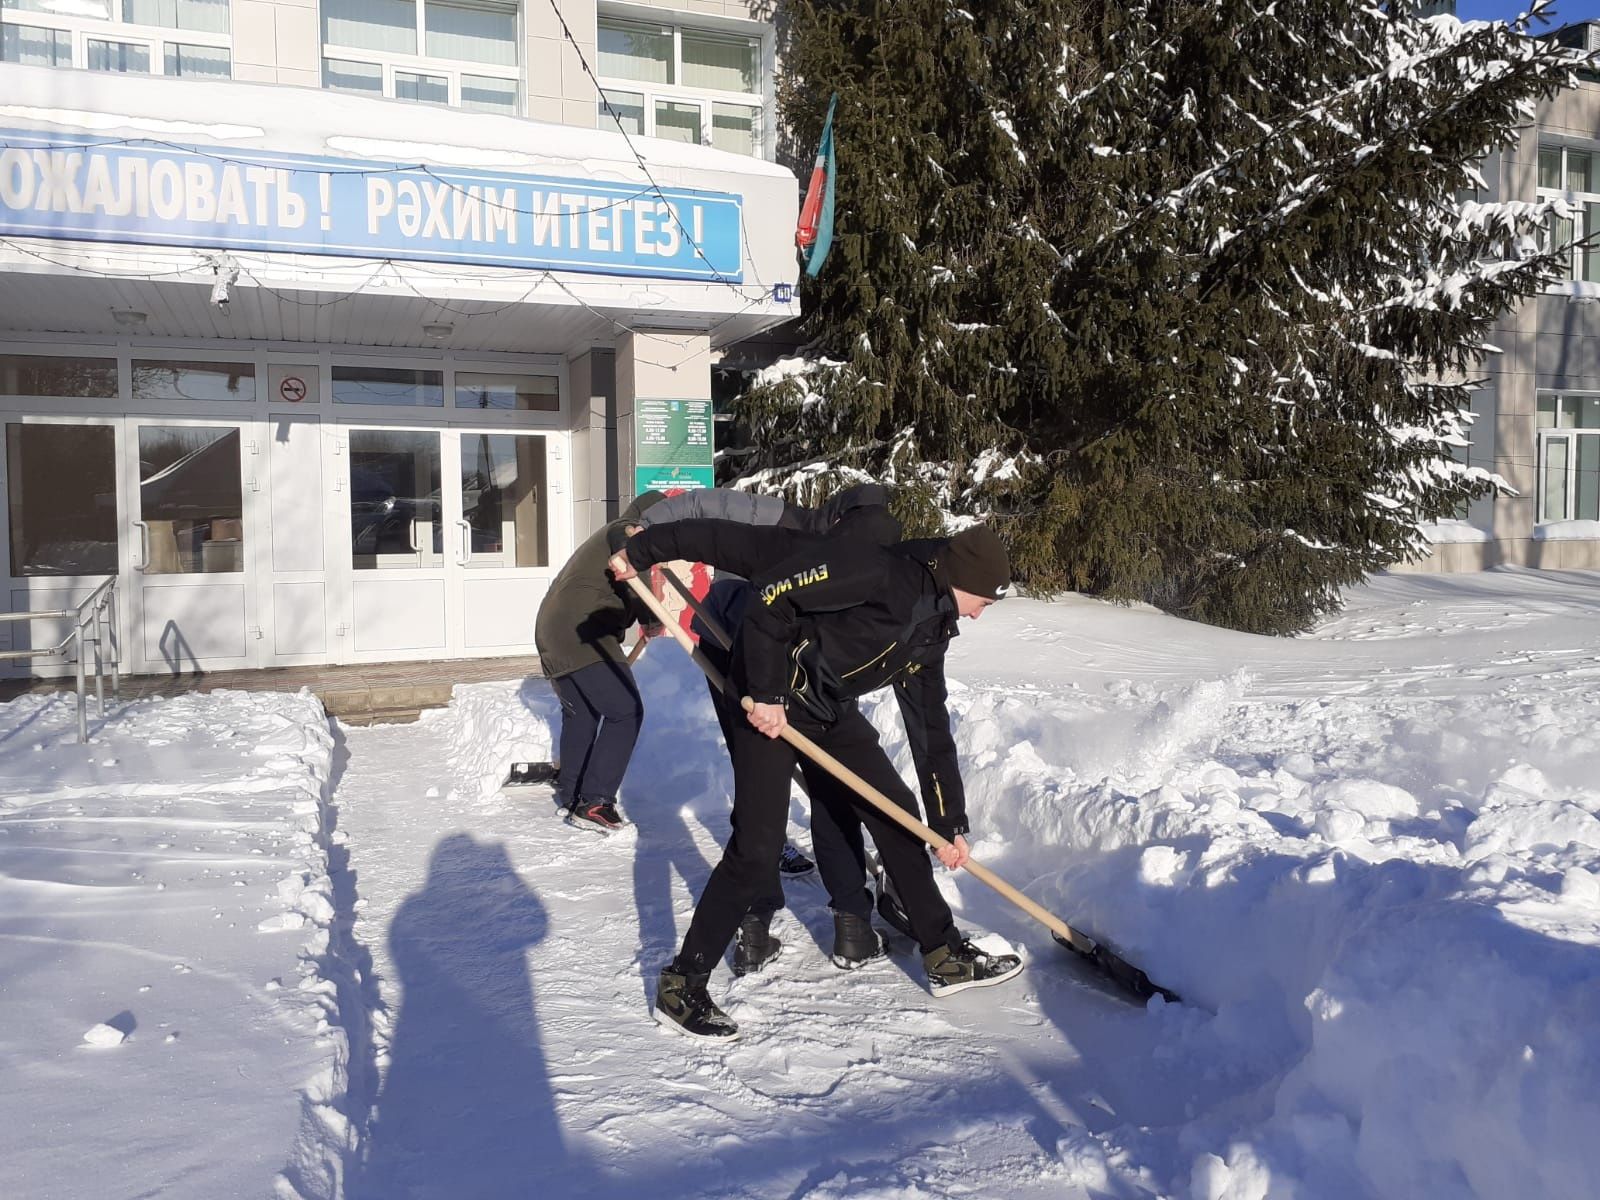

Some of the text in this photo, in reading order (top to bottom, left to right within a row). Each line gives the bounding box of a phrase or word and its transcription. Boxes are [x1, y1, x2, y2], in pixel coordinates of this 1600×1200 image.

[367, 177, 517, 244] РӘХИМ
[532, 191, 680, 257] ИТЕГЕЗ
[794, 563, 829, 587] EVIL
